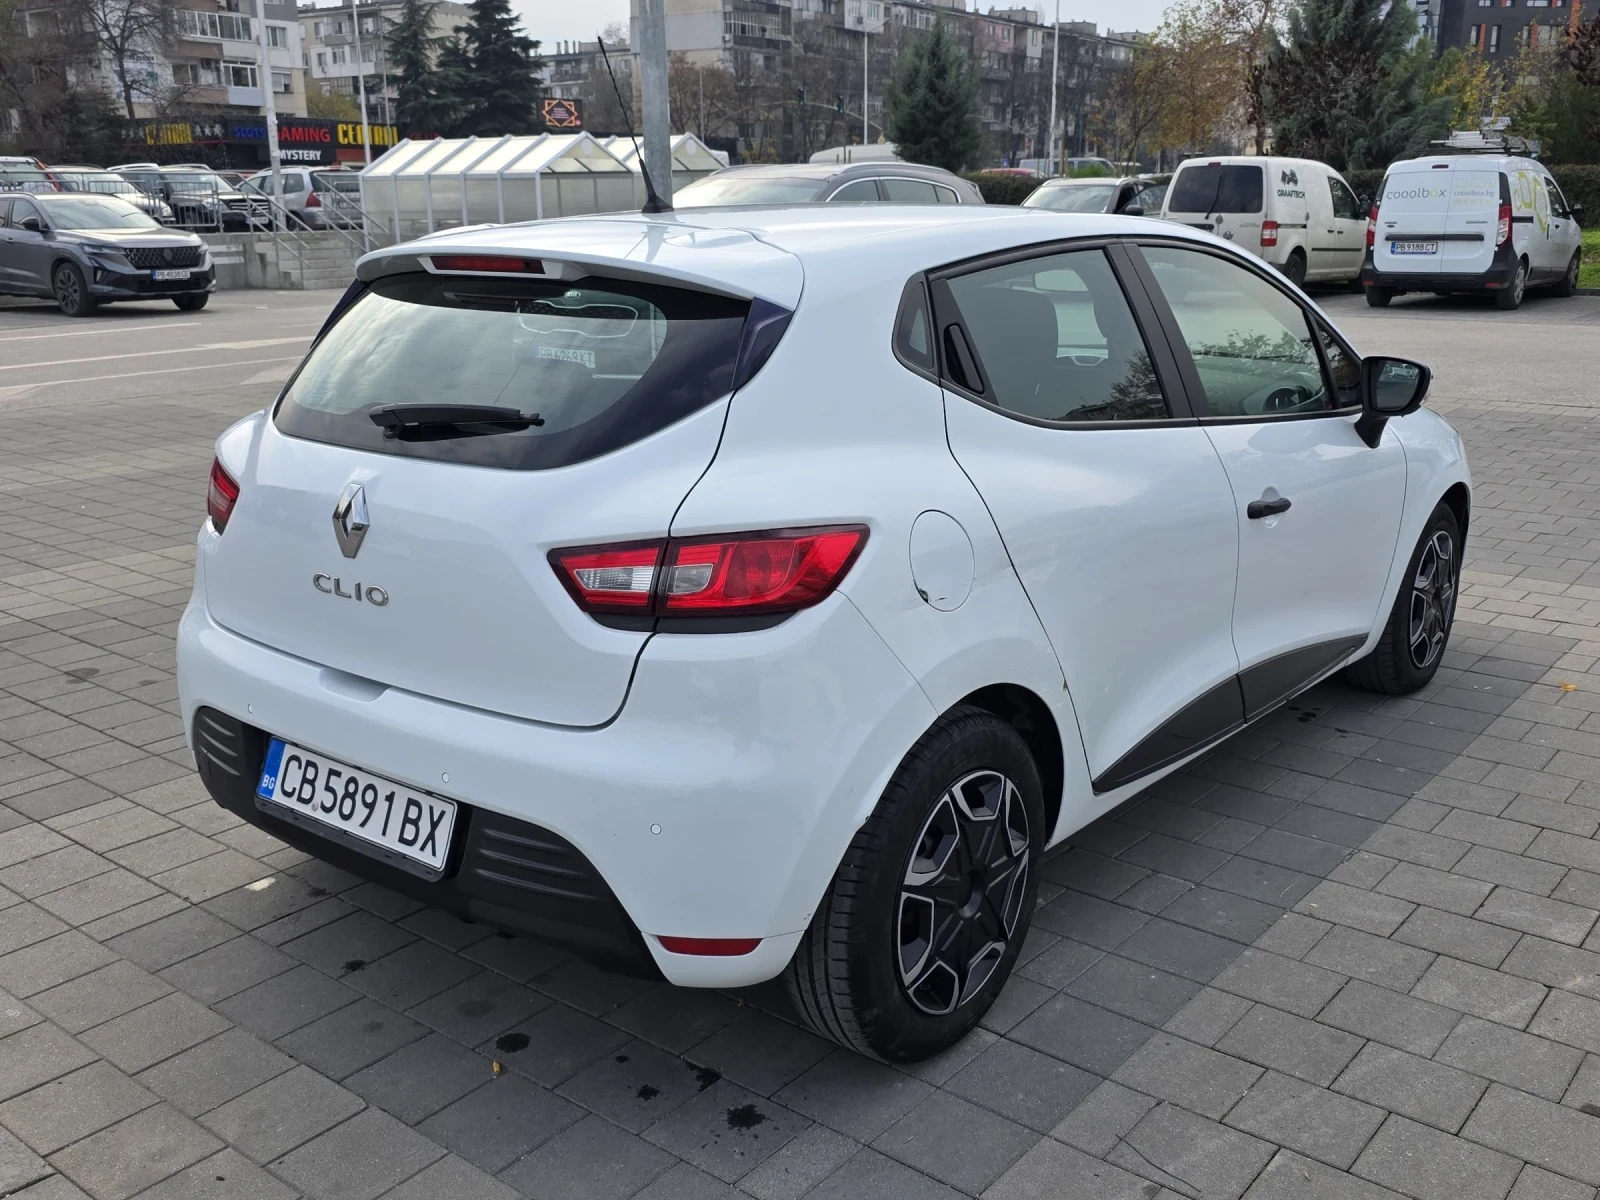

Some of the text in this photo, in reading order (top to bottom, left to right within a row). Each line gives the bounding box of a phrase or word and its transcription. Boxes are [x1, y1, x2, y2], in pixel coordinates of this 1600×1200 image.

[233, 127, 331, 143] SLOTS AMING
[279, 149, 322, 161] MYSTERY
[1386, 187, 1447, 200] cooolbox
[1453, 189, 1495, 198] cooolbox.bg
[312, 572, 389, 607] CLIO
[261, 773, 276, 790] BG
